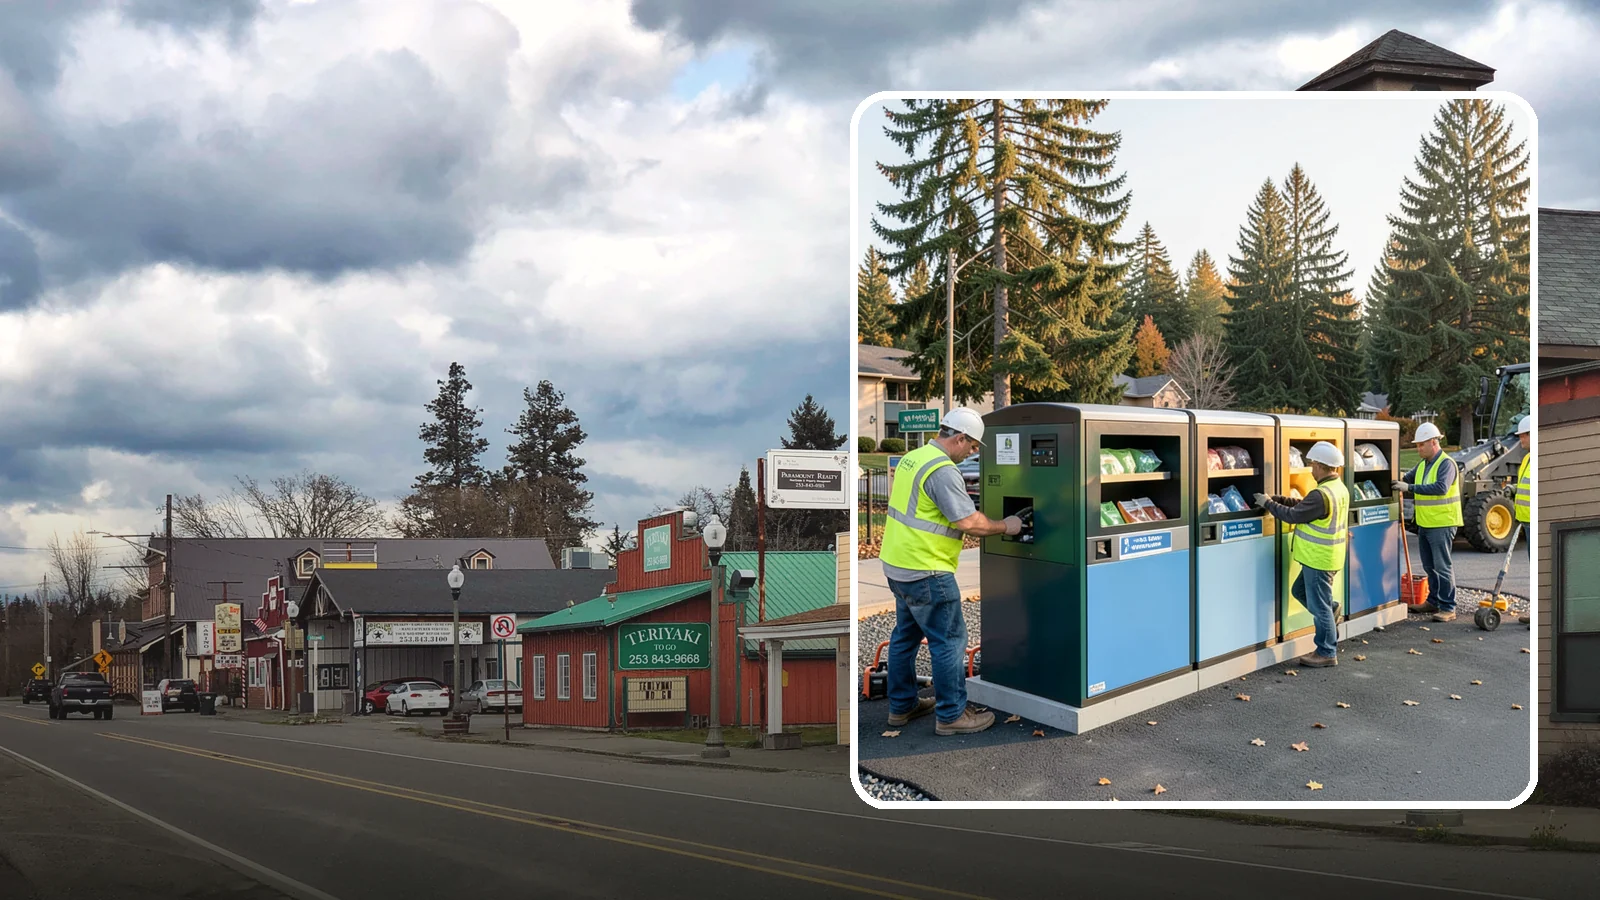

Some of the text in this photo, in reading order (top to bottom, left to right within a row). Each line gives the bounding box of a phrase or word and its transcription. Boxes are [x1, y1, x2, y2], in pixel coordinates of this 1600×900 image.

[625, 627, 702, 645] TERIYAKI
[629, 654, 700, 664] 253 843-9668
